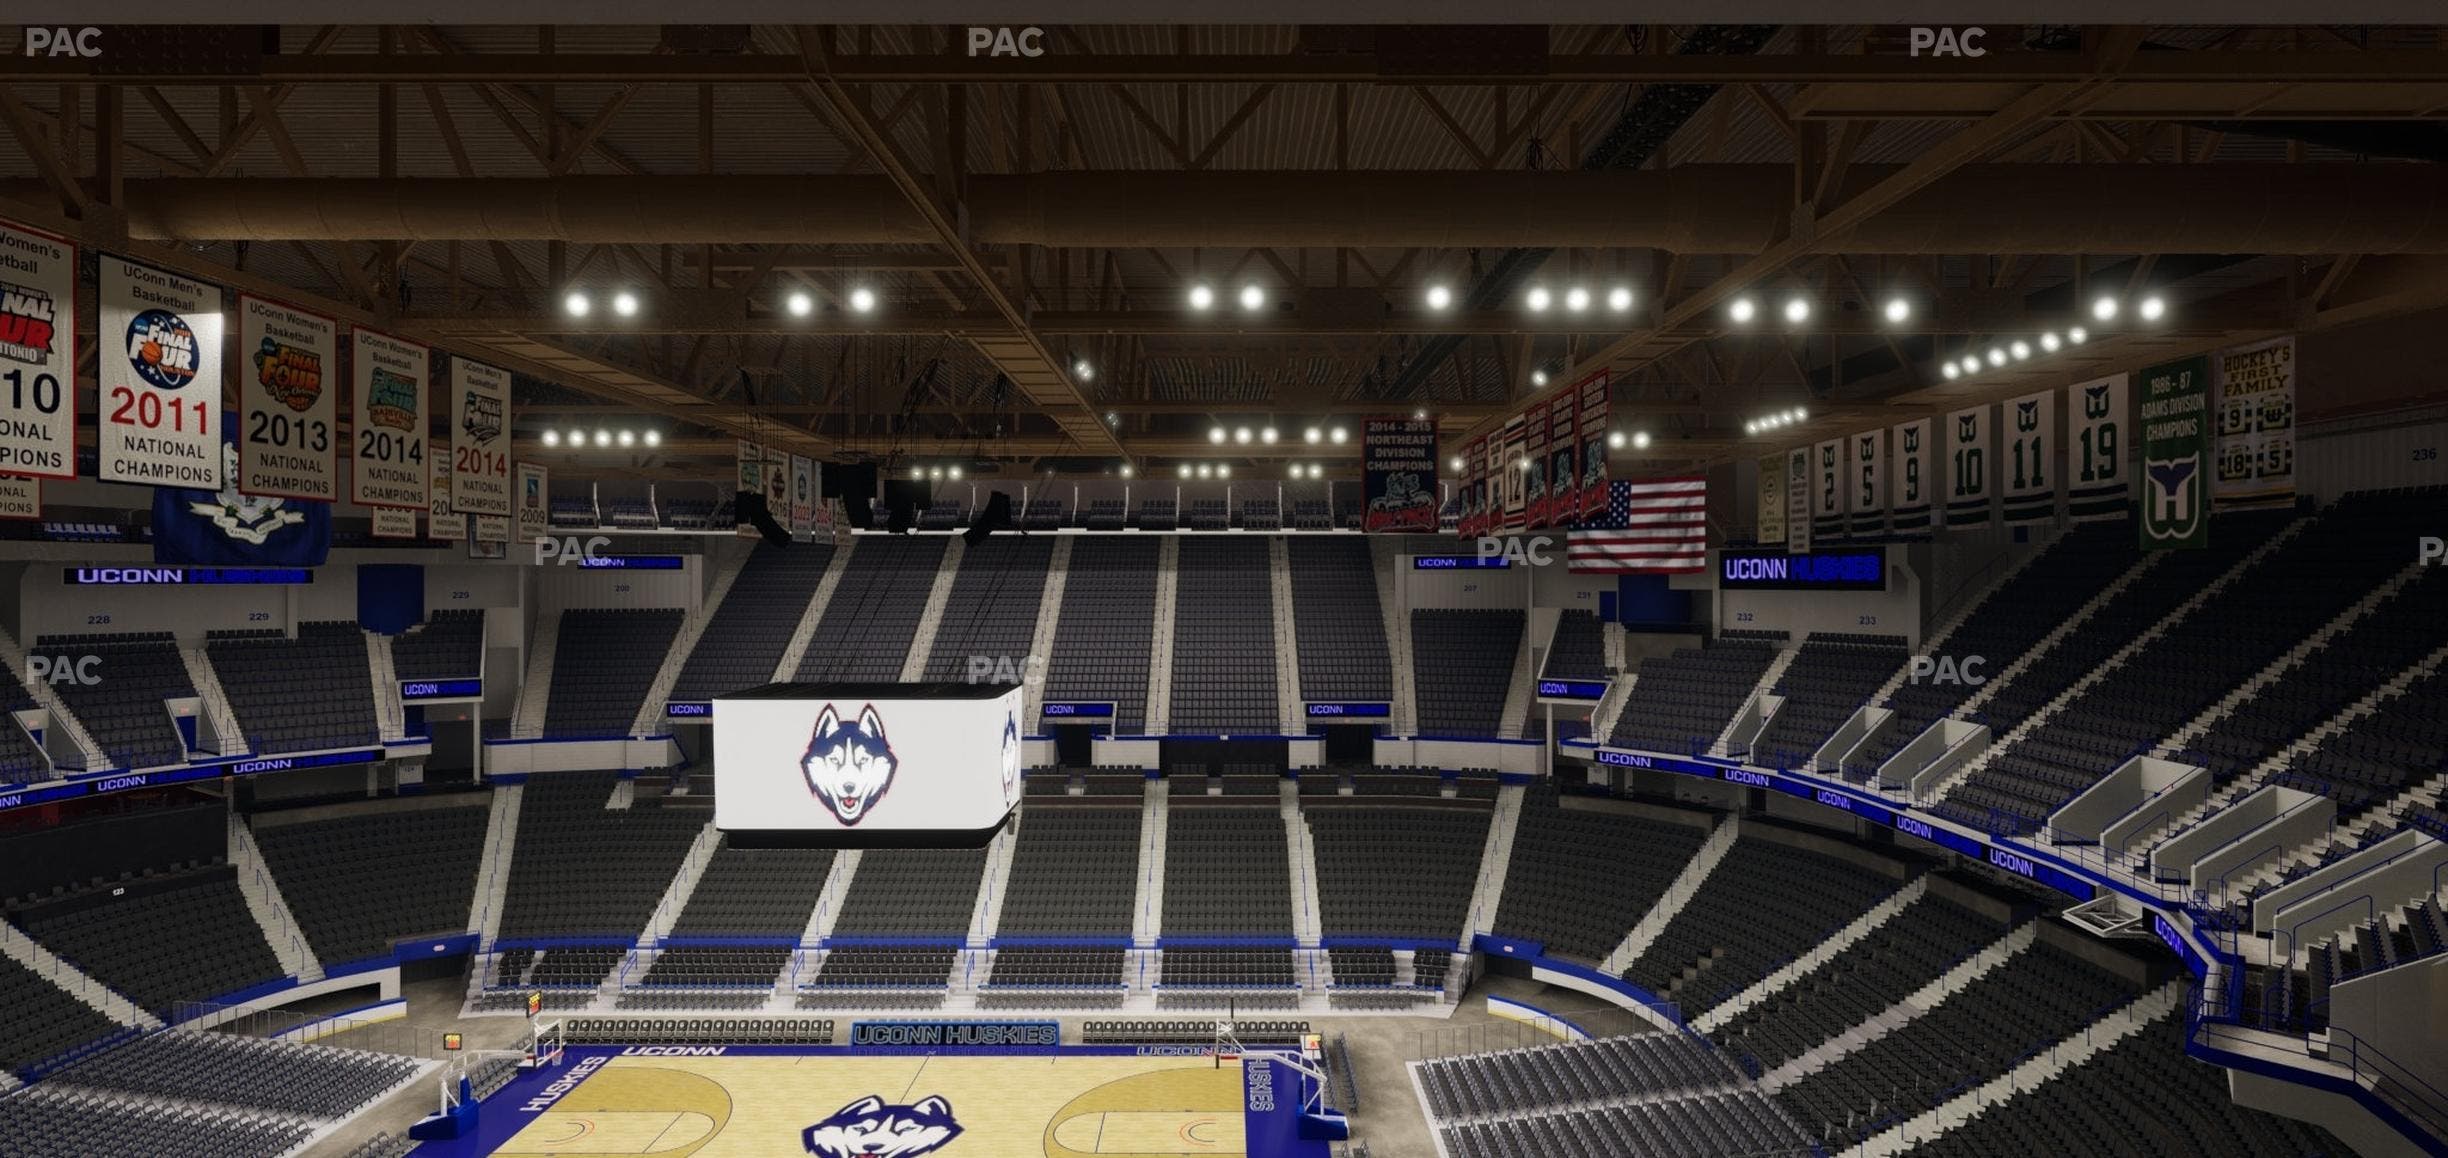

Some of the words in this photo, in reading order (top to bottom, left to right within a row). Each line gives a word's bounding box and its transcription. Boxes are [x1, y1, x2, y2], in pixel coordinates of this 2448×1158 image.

[124, 264, 166, 286] UConn
[169, 278, 203, 297] Men's
[0, 291, 53, 321] NAL
[133, 286, 195, 312] Basketball
[265, 323, 315, 345] Basketball
[2224, 345, 2290, 372] HOCKEY'S
[2231, 364, 2282, 383] FIRST
[2224, 374, 2289, 397] FAMILY
[111, 387, 207, 435] 2011
[2142, 399, 2169, 419] ADAMS
[2169, 392, 2205, 417] DIVISION
[2230, 409, 2240, 428] 9
[250, 410, 328, 453] 2013
[2146, 417, 2198, 442] CHAMPIONS
[125, 435, 206, 459] NATIONAL
[360, 429, 422, 465] 2014
[1366, 435, 1434, 446] NORTHEAST
[457, 446, 507, 478] 2014
[1375, 448, 1426, 458] DIVISION
[2081, 422, 2117, 483] 19
[2269, 450, 2281, 470] 5
[2412, 447, 2437, 462] 236
[114, 459, 213, 483] CHAMPIONS
[260, 453, 323, 473] NATIONAL
[1367, 461, 1434, 472] CHAMPIONS
[1955, 448, 1983, 496] 10
[2014, 436, 2043, 489] 11
[252, 474, 329, 494] CHAMPIONS
[368, 467, 419, 484] NATIONAL
[1906, 457, 1919, 502] 9
[362, 486, 424, 503] CHAMPIONS
[463, 480, 503, 494] NATIONAL
[1824, 473, 1835, 512] 2
[1862, 465, 1874, 507] 5
[458, 496, 508, 511] CHAMPIONS
[520, 508, 545, 524] 2009
[582, 558, 625, 567] UCONN
[1418, 558, 1457, 568] UCONN
[1725, 557, 1787, 581] UCONN
[77, 568, 183, 584] UCONN
[88, 615, 110, 625] 228
[249, 613, 269, 622] 229
[1737, 612, 1754, 622] 232
[1859, 616, 1876, 626] 233
[404, 682, 438, 696] UCONN
[1540, 682, 1568, 695] UCONN
[669, 704, 704, 715] UCONN
[1045, 704, 1075, 715] UCONN
[1309, 704, 1343, 715] UCONN
[233, 758, 292, 774] UCONN
[1598, 751, 1652, 768] UCONN
[97, 775, 146, 793] UCONN
[1724, 769, 1770, 787] UCONN
[1817, 789, 1851, 810] UCONN
[1896, 815, 1932, 840] UCONN
[1988, 846, 2034, 878] UCONN
[855, 1025, 942, 1045] UCONN
[944, 1025, 1057, 1045] HUSKIES
[620, 1046, 727, 1056] UCONN
[1136, 1046, 1242, 1057] UCONN
[520, 1056, 607, 1112] HUSKIES
